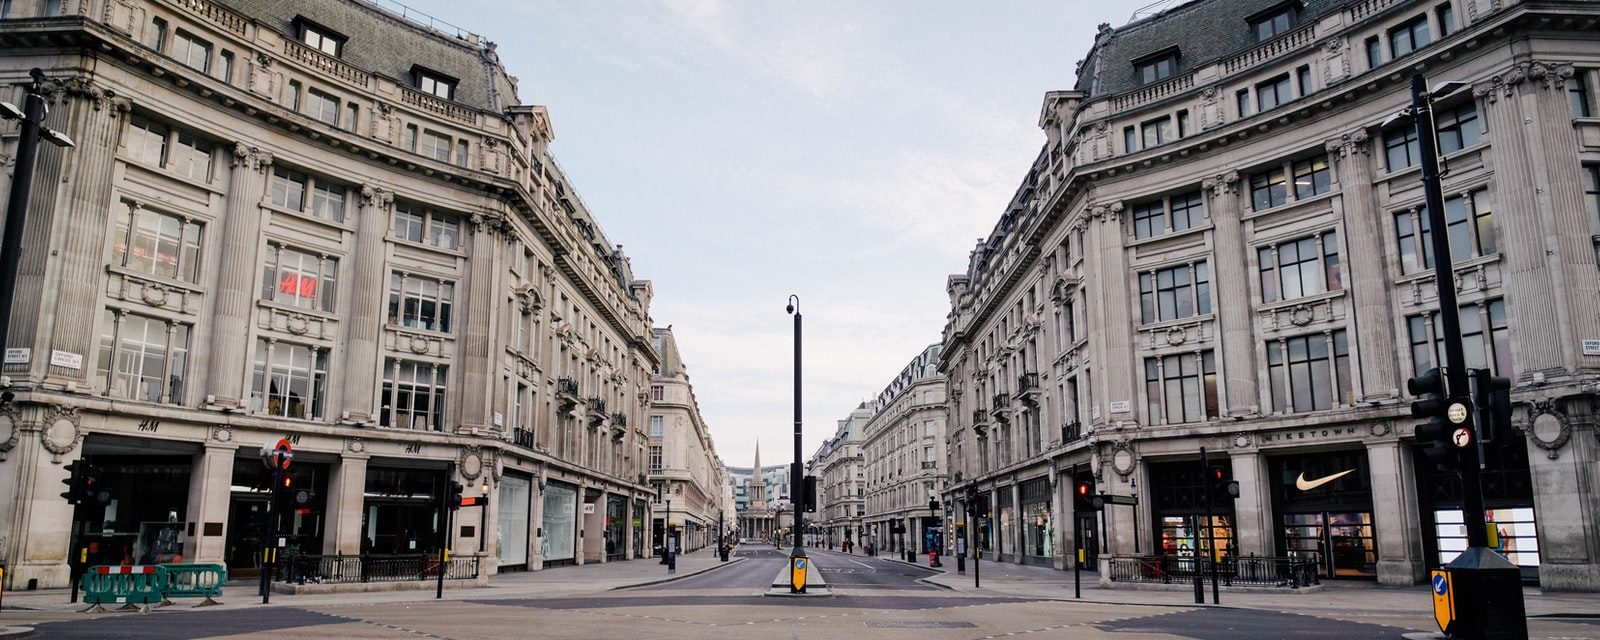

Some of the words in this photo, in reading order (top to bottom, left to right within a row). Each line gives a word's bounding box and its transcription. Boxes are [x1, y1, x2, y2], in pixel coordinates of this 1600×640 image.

[280, 273, 317, 299] H&M
[138, 419, 160, 432] H&M
[1265, 427, 1355, 442] NIKETOWN
[405, 444, 421, 454] H&M
